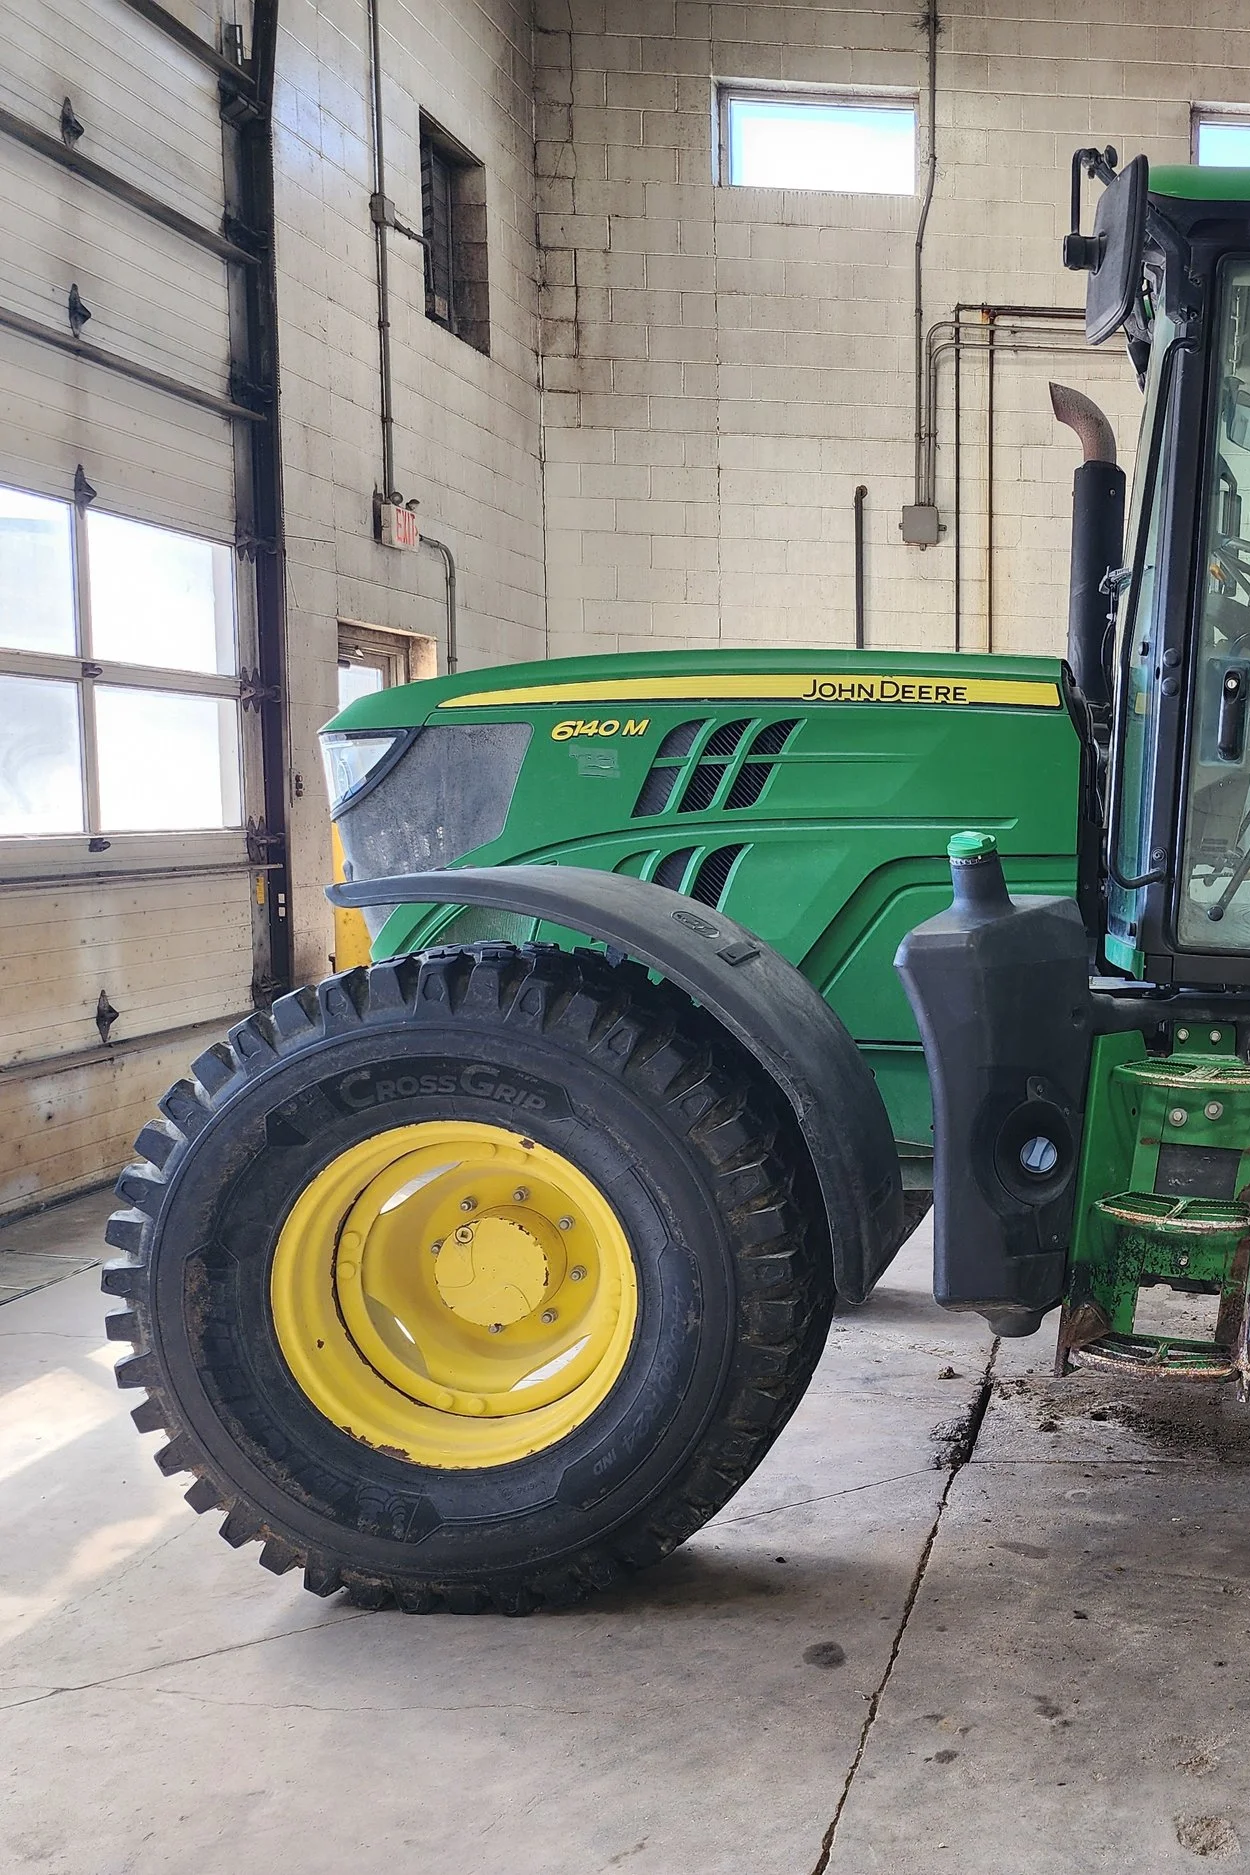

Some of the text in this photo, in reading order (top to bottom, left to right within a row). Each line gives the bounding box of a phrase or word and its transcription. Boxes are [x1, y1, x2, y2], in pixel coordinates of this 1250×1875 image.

[396, 508, 415, 546] EXIT
[803, 679, 967, 702] JOHN DEERE
